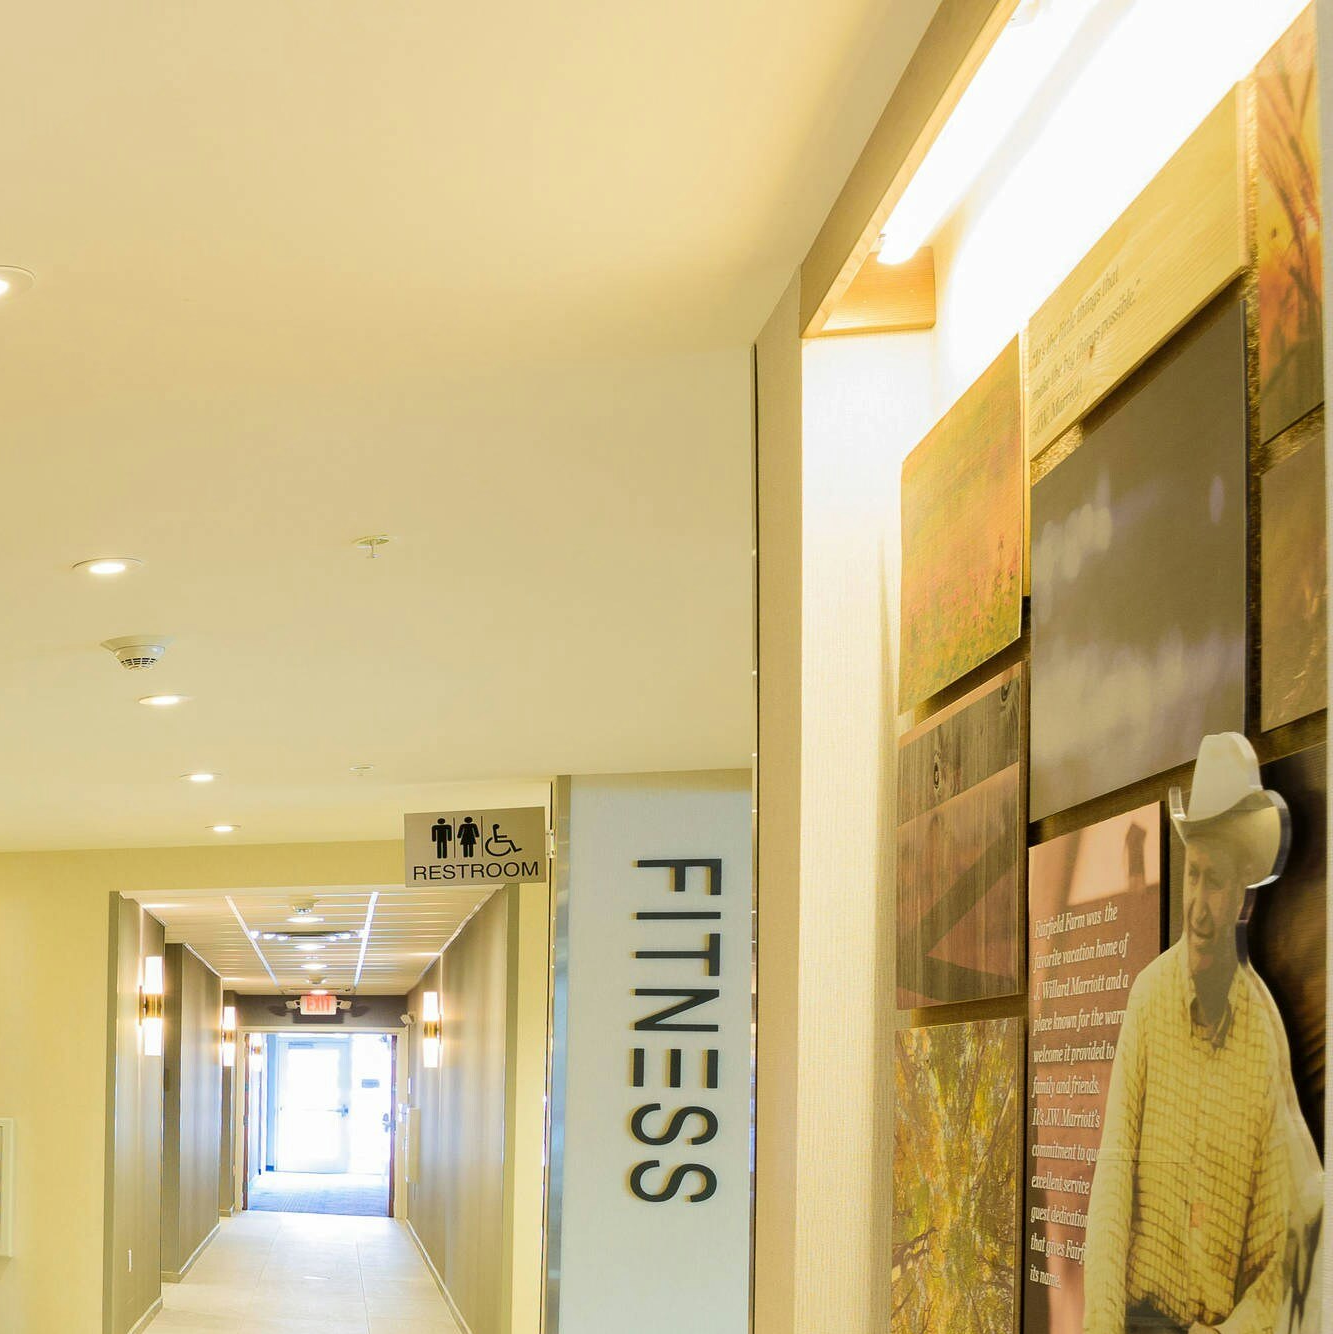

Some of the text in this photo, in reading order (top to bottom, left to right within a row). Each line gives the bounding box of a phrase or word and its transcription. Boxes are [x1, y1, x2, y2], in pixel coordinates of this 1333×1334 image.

[414, 861, 539, 880] RESTROOM
[1035, 901, 1118, 940] Fairfield Farm was the
[1033, 932, 1130, 974] favorite vacation home of
[1042, 978, 1070, 999] Willard
[1069, 974, 1105, 995] Marriott
[1105, 969, 1122, 990] and
[1122, 974, 1129, 988] a
[630, 858, 723, 1203] FITNESS
[1033, 1013, 1052, 1036] place
[1053, 1011, 1077, 1030] known
[1077, 1008, 1090, 1032] for
[1091, 1007, 1104, 1026] the
[1034, 1040, 1114, 1065] welcome it provided to
[1032, 1075, 1100, 1098] family and friends.
[1031, 1107, 1100, 1128] It's J.W. Marriott's
[1032, 1141, 1077, 1160] commitment
[1077, 1145, 1085, 1160] to
[1031, 1171, 1090, 1194] excellent service
[1031, 1206, 1050, 1223] guest
[1031, 1233, 1045, 1252] that
[1045, 1241, 1065, 1258] gives
[1030, 1264, 1039, 1282] its
